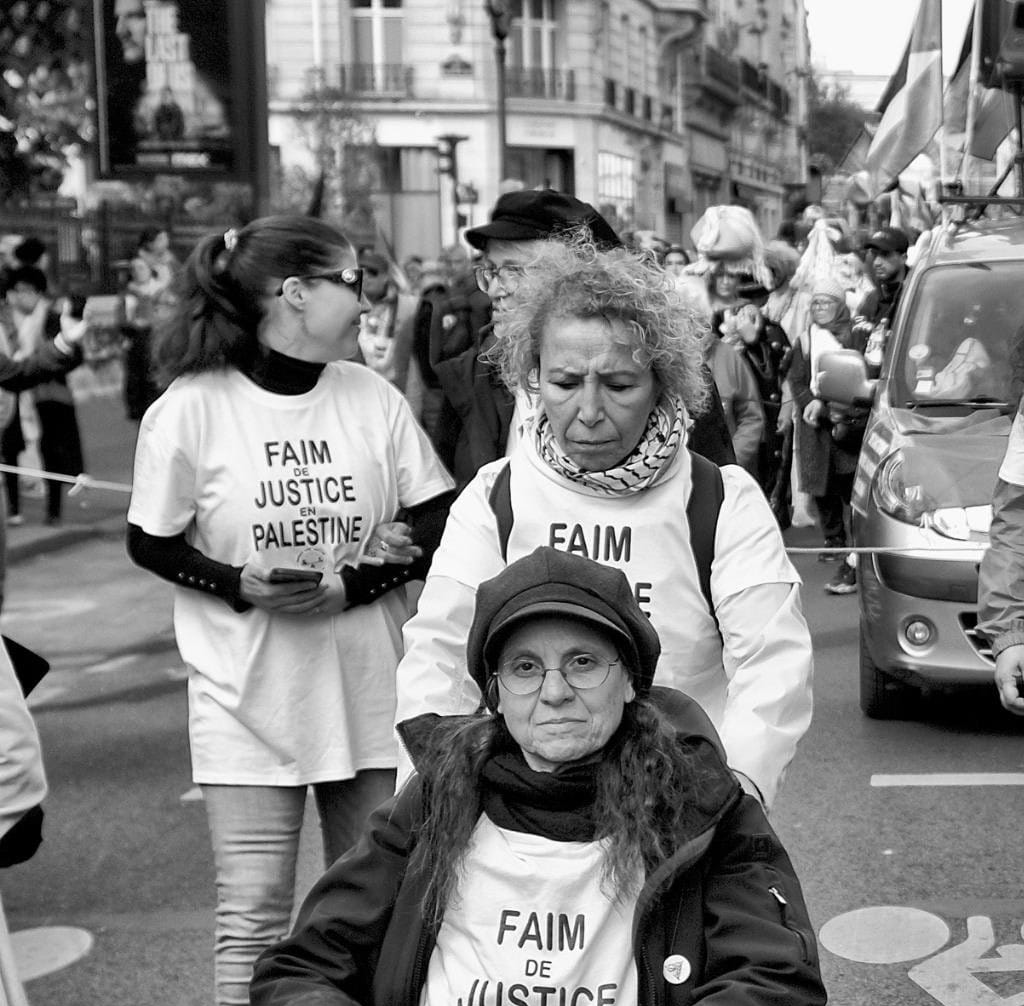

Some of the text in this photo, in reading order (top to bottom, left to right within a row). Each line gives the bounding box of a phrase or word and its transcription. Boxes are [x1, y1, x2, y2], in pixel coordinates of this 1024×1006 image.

[264, 439, 332, 467] FAIM
[293, 467, 310, 476] DE
[255, 476, 356, 508] JUSTICE
[299, 507, 316, 516] EN
[252, 516, 362, 551] PALESTINE
[550, 523, 632, 562] FAIM
[497, 909, 585, 952] FAIM
[525, 959, 552, 978] DE
